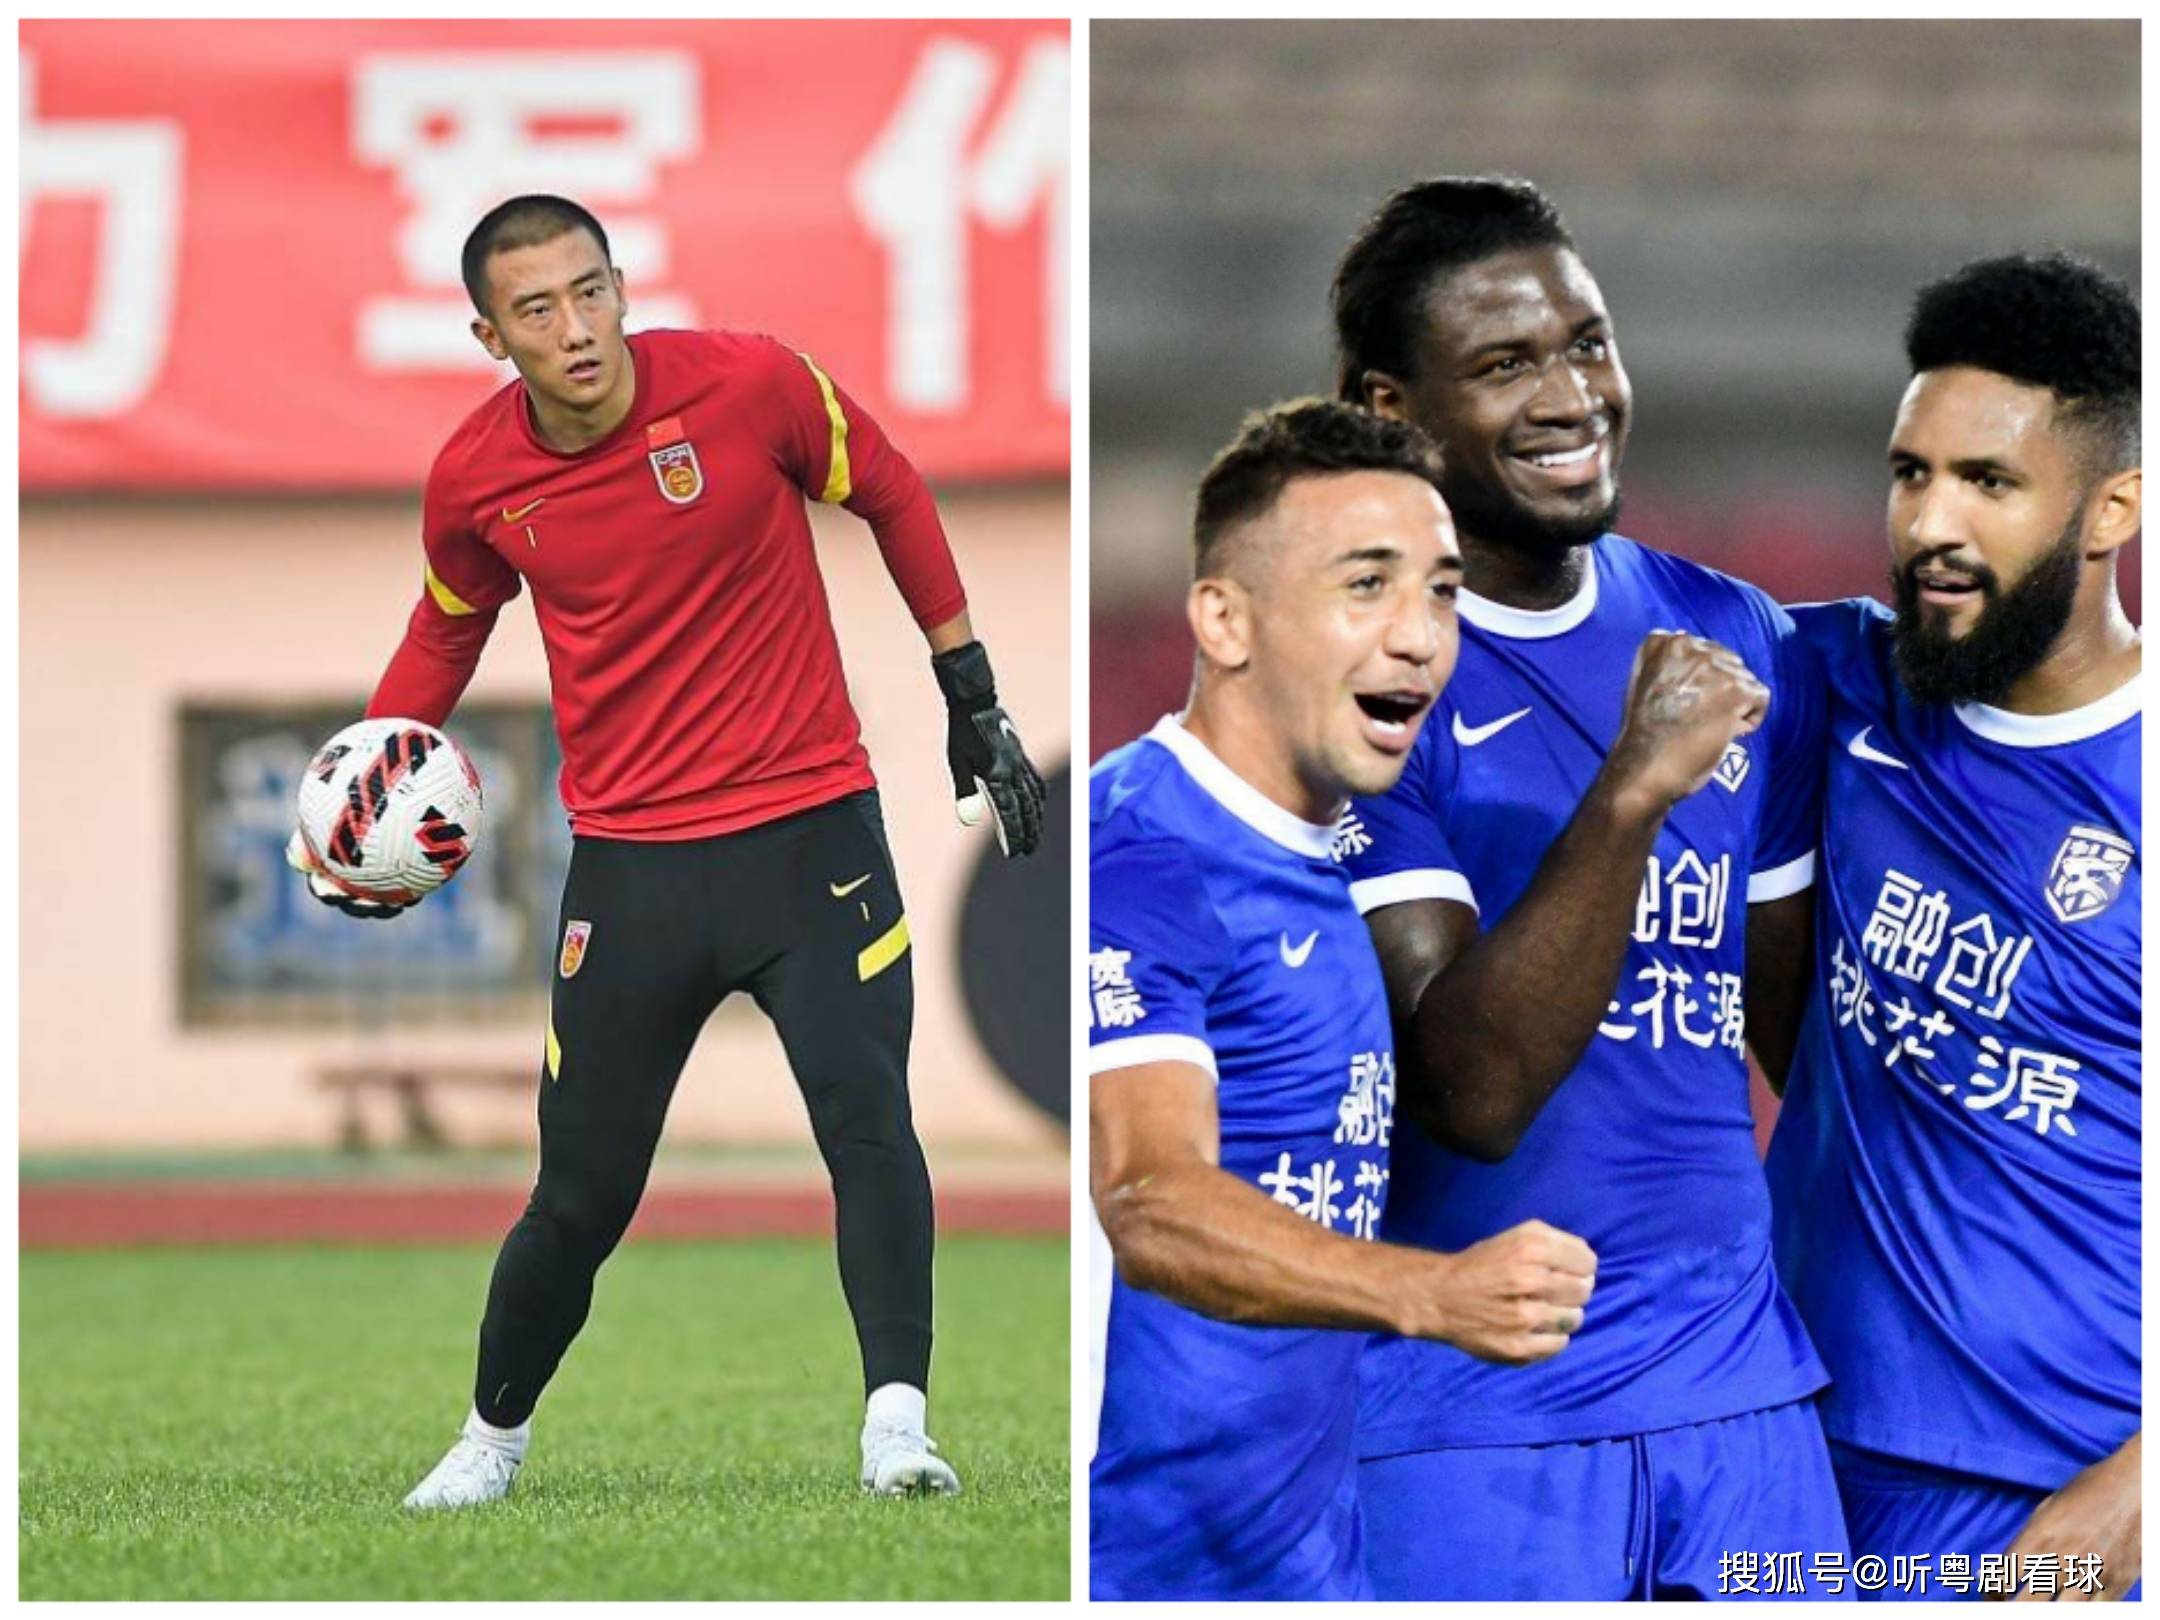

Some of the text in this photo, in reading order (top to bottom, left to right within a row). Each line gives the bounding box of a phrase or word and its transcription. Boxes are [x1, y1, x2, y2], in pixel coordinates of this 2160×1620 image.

[1861, 868, 2034, 1020] 融创
[1829, 937, 2081, 1137] 桃花源
